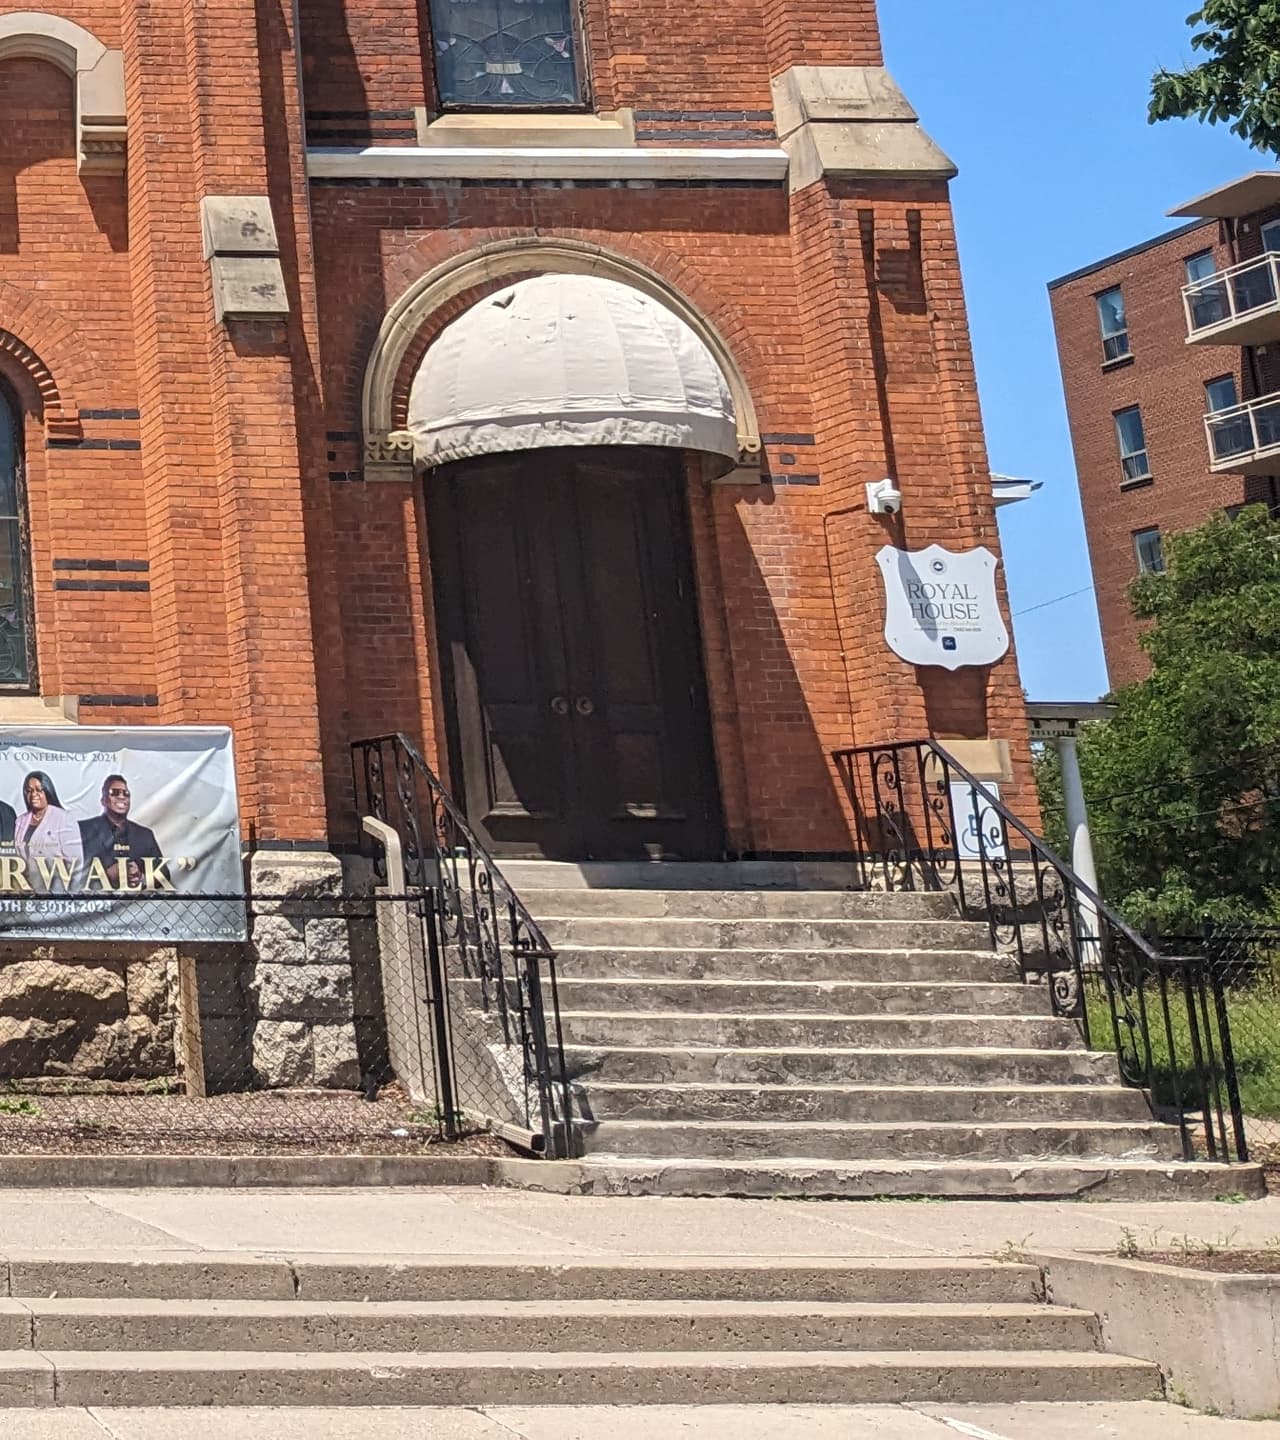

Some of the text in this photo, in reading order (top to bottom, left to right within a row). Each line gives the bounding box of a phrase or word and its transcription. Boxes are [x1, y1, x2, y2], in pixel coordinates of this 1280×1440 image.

[907, 583, 978, 600] ROYAL
[910, 603, 980, 620] HOUSE
[14, 751, 89, 763] CONFERENCE
[91, 752, 118, 763] 2024
[25, 900, 37, 913] &
[40, 900, 76, 913] 30TH
[78, 900, 112, 913] 2024
